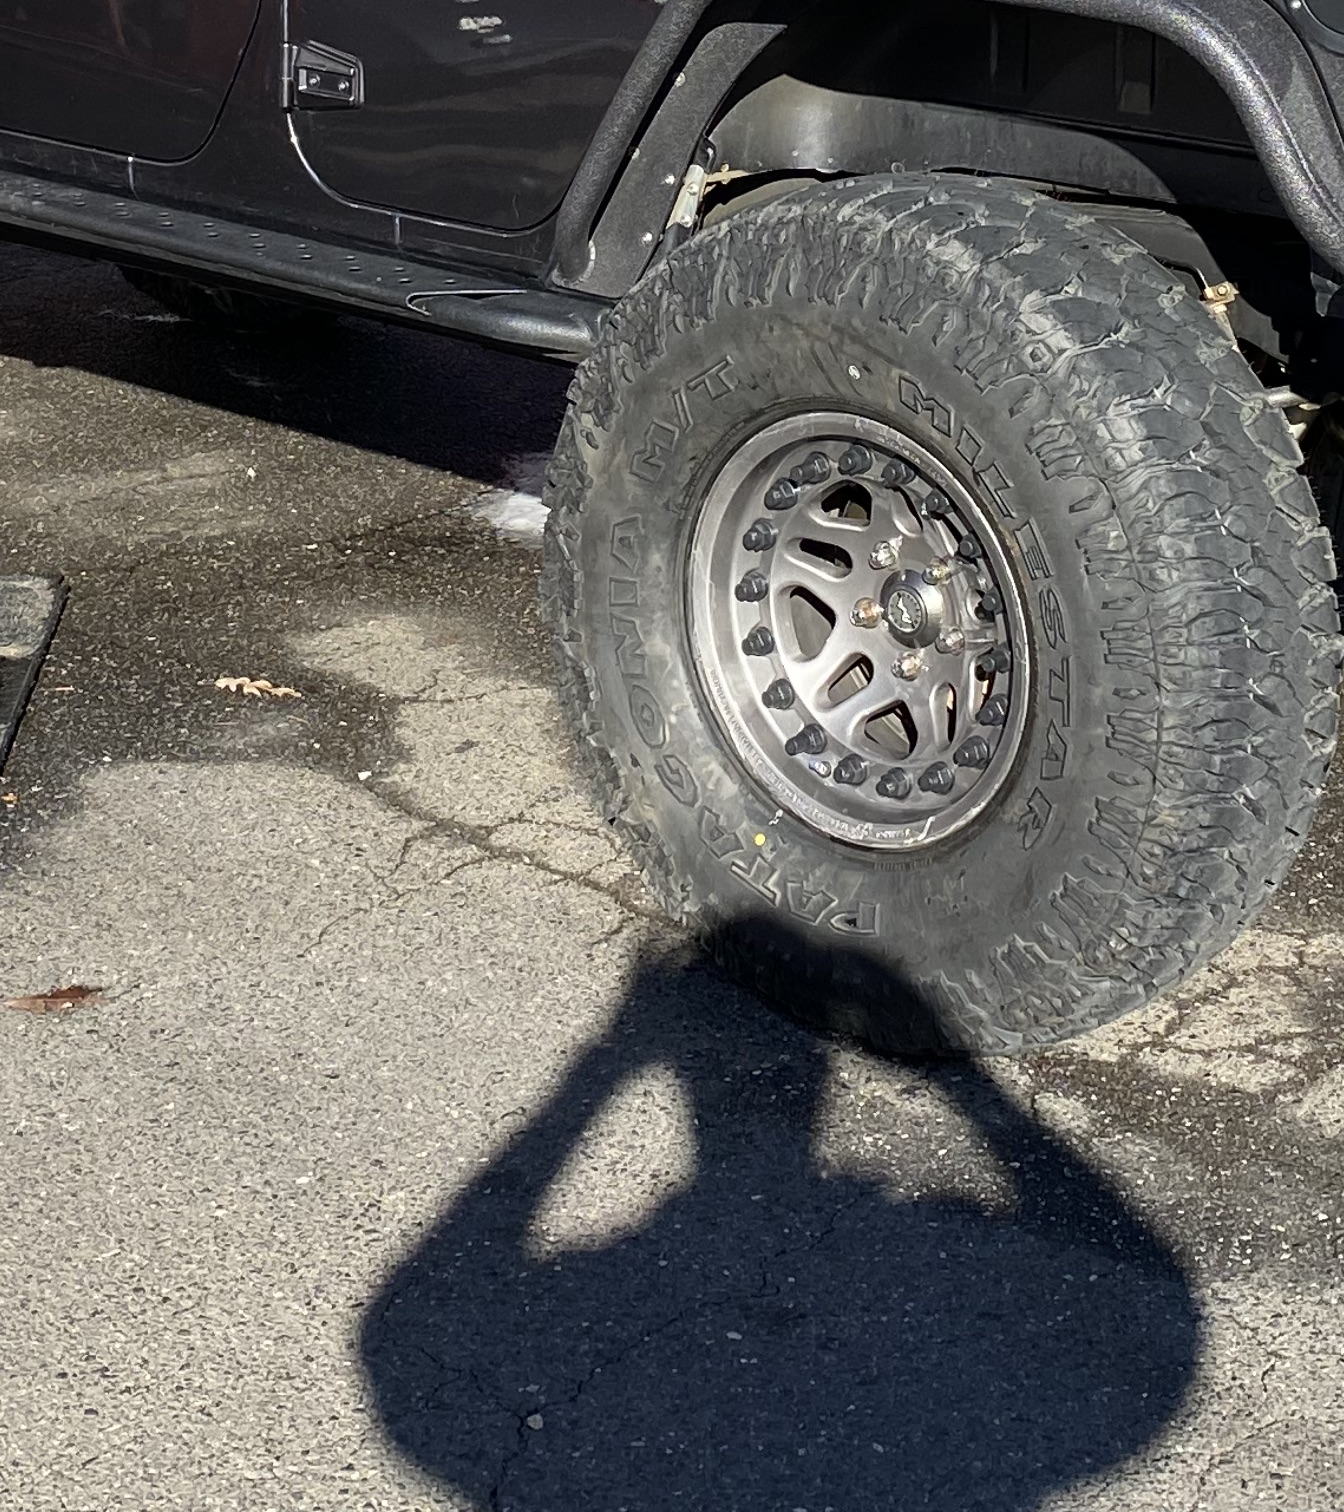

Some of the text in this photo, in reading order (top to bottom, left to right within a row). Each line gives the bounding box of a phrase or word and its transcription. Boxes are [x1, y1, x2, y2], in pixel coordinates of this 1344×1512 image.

[629, 354, 737, 484] M/T
[897, 374, 1075, 853] MILESTAR
[606, 514, 882, 938] PATAGONIA
